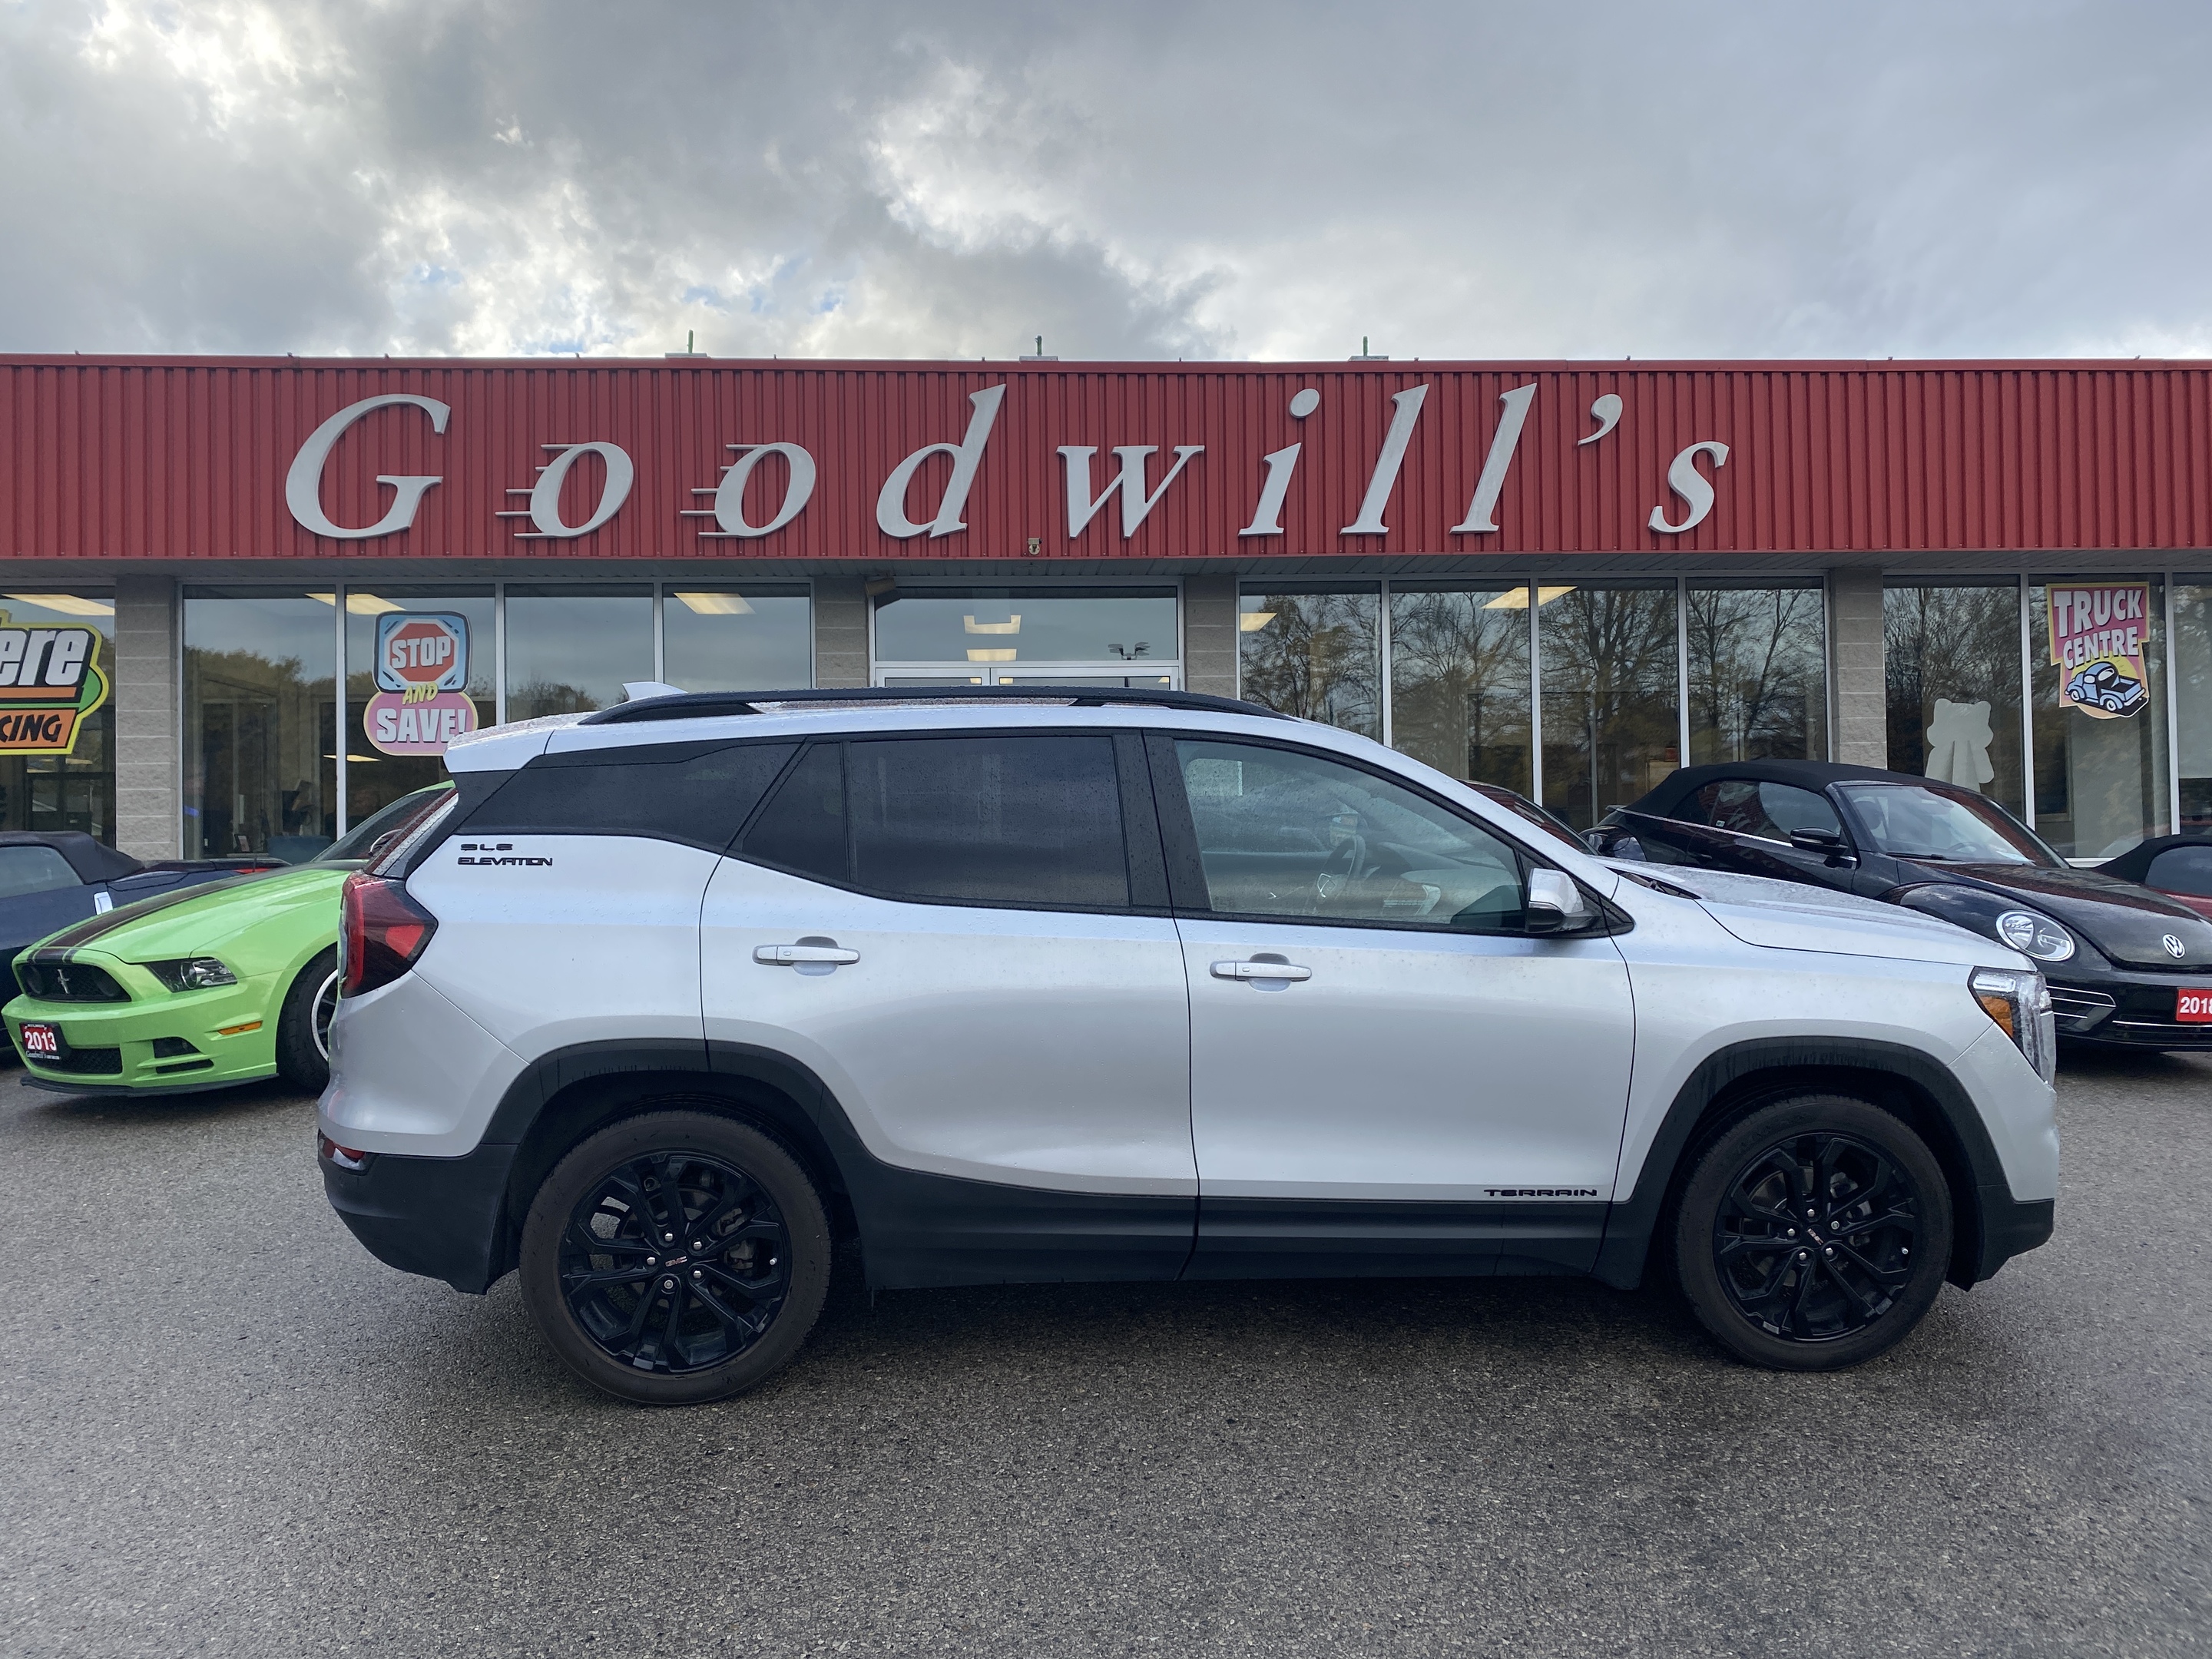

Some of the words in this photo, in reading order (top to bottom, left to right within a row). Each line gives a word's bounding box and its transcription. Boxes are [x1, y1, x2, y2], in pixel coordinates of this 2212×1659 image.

[285, 382, 1730, 540] Goodwill's
[2054, 589, 2143, 637] TRUCK
[0, 630, 89, 686] ere
[392, 636, 451, 669] STOP
[2063, 627, 2139, 670] CENTRE
[402, 682, 439, 704] AND
[0, 714, 62, 743] CING
[376, 708, 466, 743] SAVE!
[458, 857, 553, 866] ELEVATION
[25, 1031, 57, 1051] 2013
